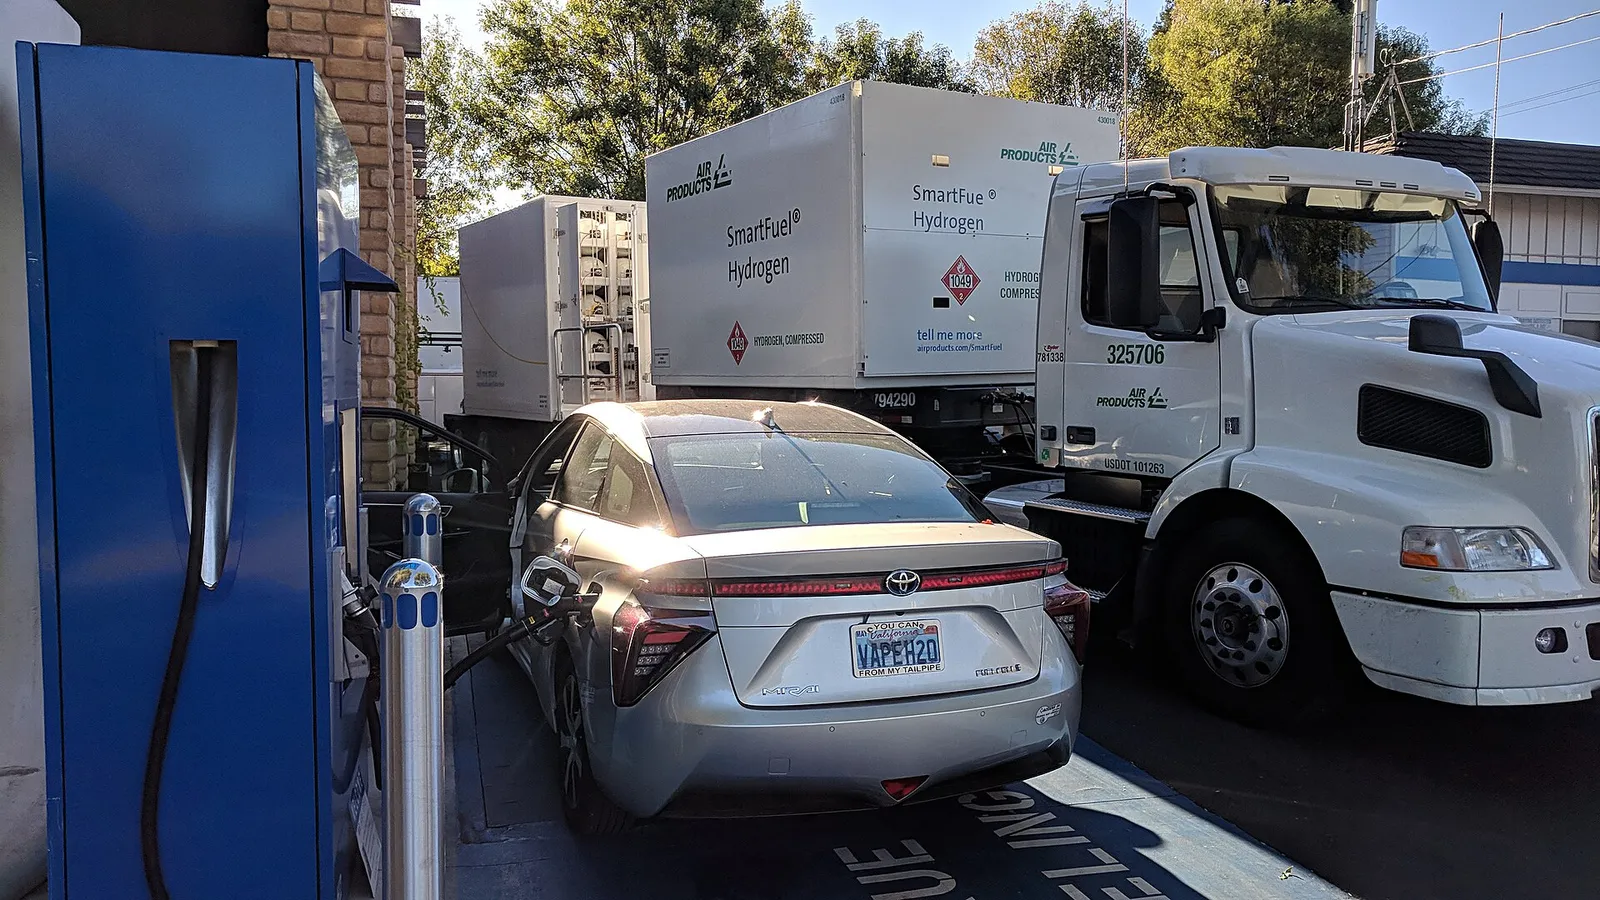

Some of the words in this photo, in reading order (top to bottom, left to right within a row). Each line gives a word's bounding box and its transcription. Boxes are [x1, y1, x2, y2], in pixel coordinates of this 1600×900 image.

[1097, 116, 1116, 125] 430018
[1038, 142, 1057, 153] AIR
[1000, 149, 1057, 164] PRODUCTS
[696, 161, 712, 179] AIR
[666, 178, 712, 203] PRODUCTS
[913, 211, 984, 234] Hydrogen
[728, 256, 789, 288] Hydrogen
[1004, 271, 1040, 283] HYDROG
[950, 275, 973, 288] 1049
[753, 335, 784, 347] HYDROGEN,
[785, 332, 824, 345] COMPRESSED
[917, 329, 934, 341] tell
[937, 331, 953, 341] me
[956, 331, 983, 340] more
[731, 338, 744, 350] 1049
[1037, 352, 1064, 362] 781338
[1107, 344, 1165, 364] 325706
[1128, 388, 1146, 398] AIR
[1096, 397, 1146, 408] PRODUCTS
[1104, 458, 1131, 472] USDOT
[1134, 461, 1165, 474] 101263
[874, 621, 895, 630] YOU
[897, 621, 919, 629] CAN
[870, 629, 919, 641] California
[859, 668, 885, 677] FROM
[887, 667, 901, 675] MY
[903, 663, 941, 673] TAILPIPE
[761, 684, 820, 697] MIRAI
